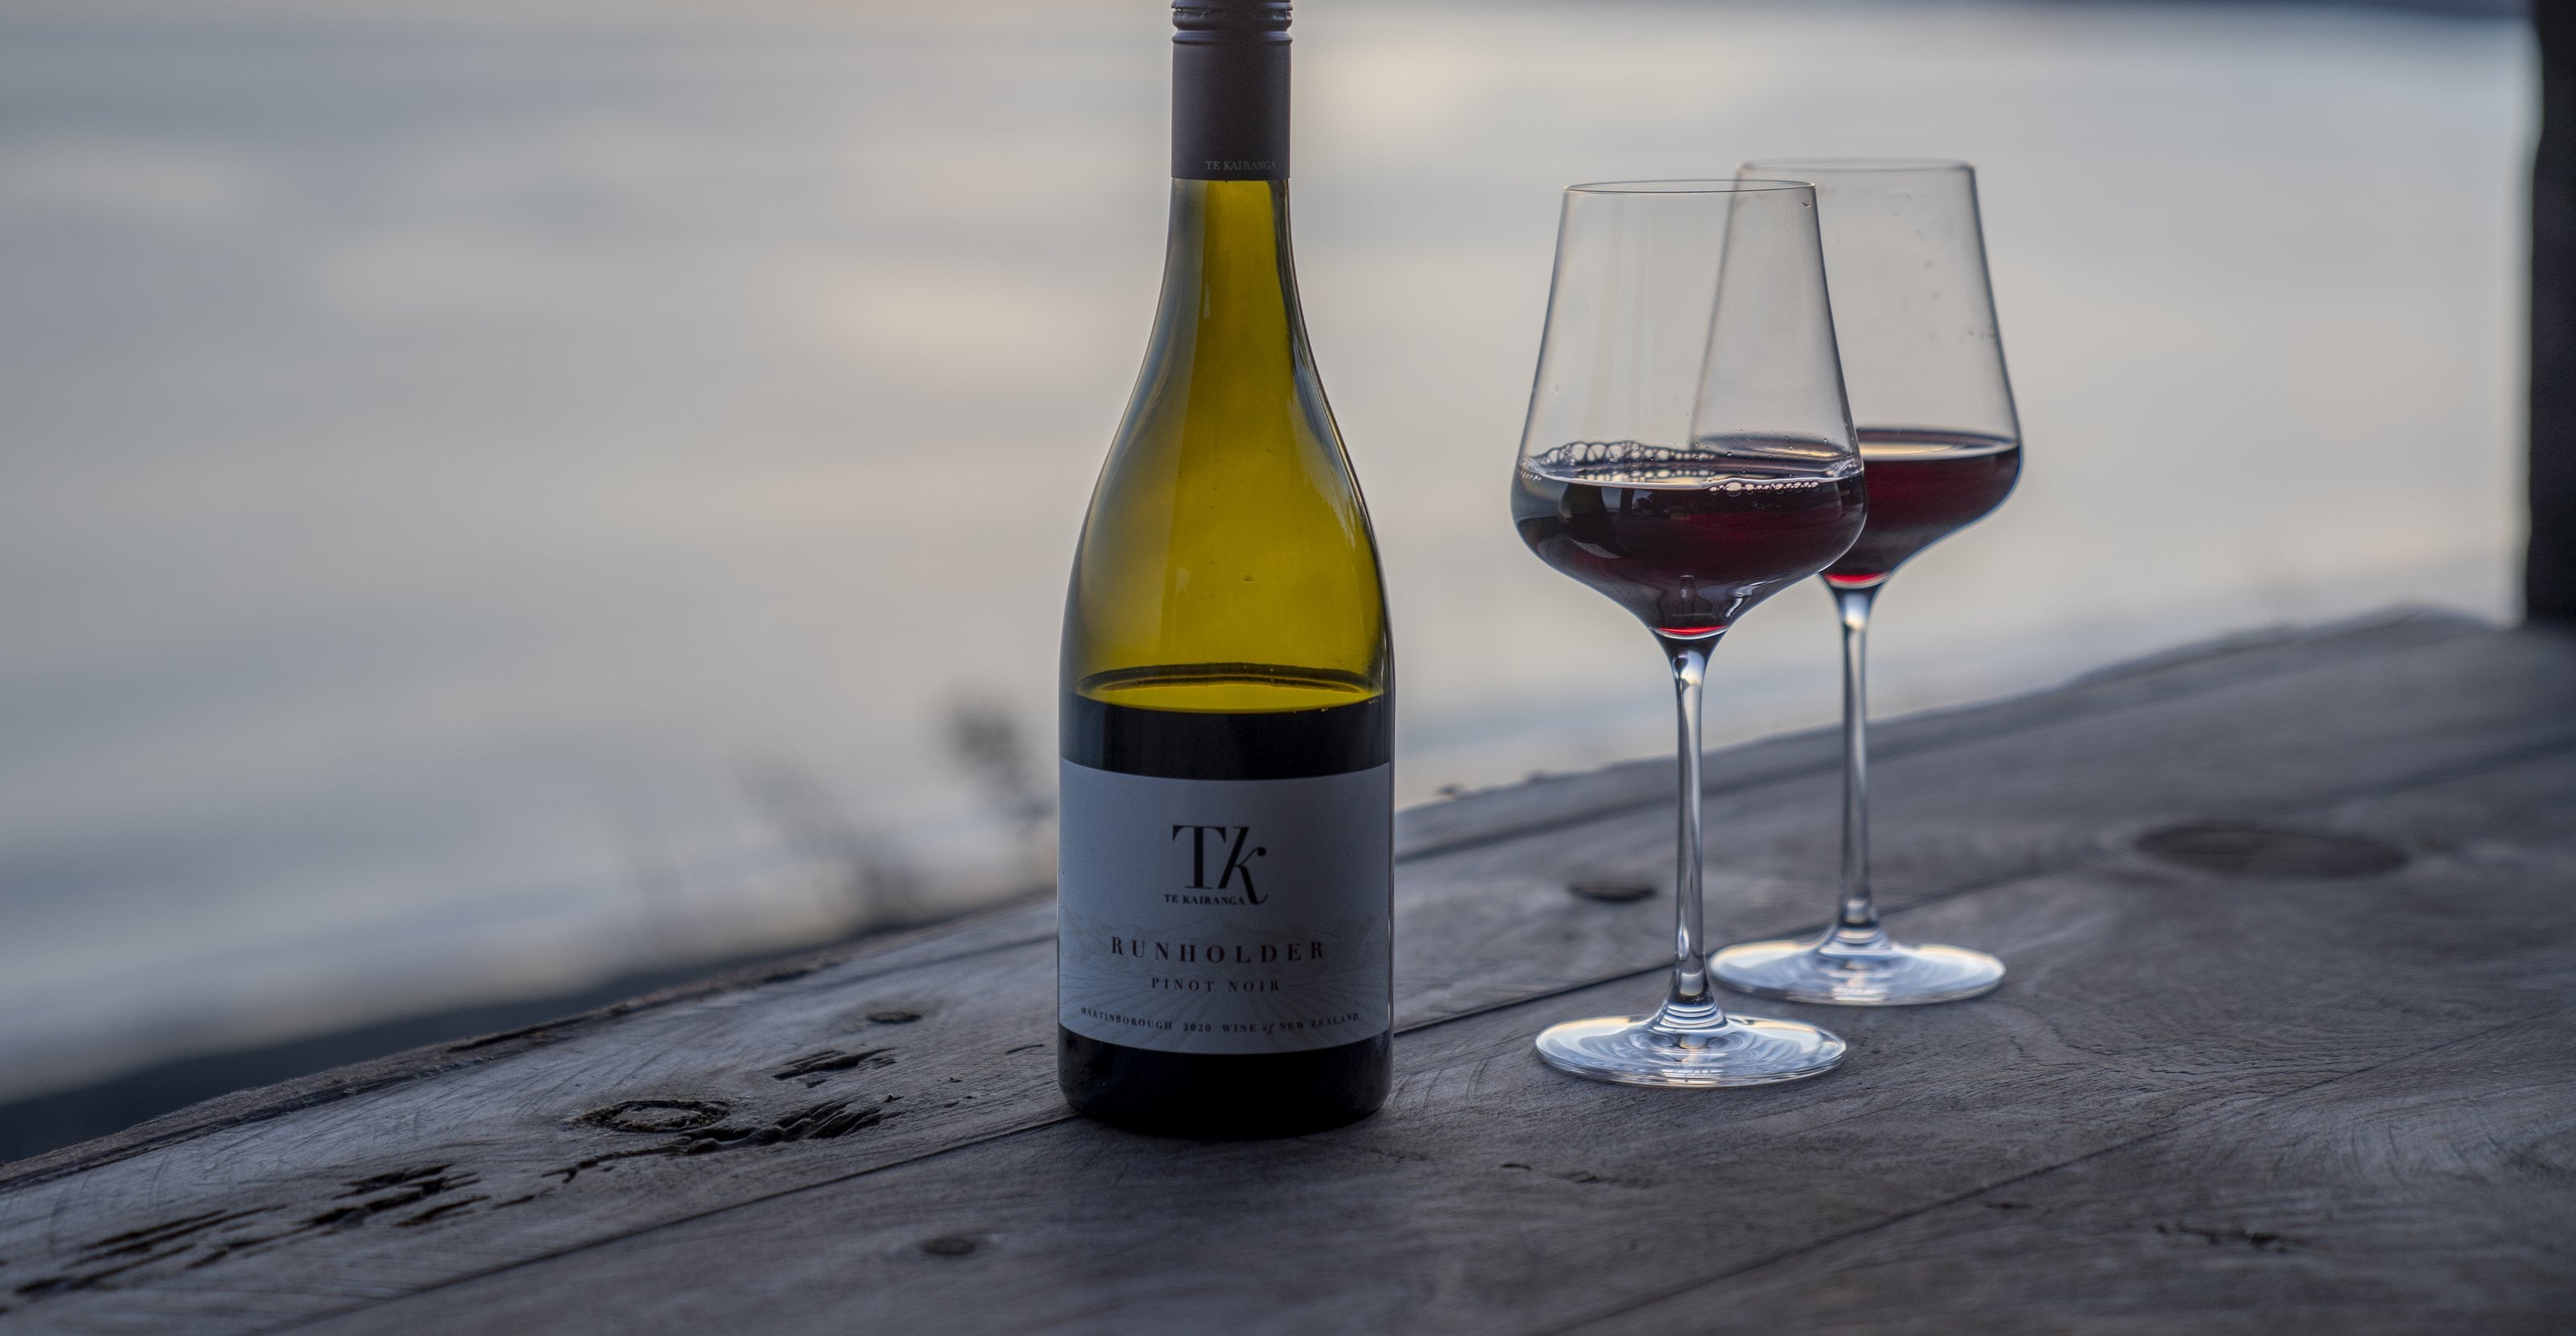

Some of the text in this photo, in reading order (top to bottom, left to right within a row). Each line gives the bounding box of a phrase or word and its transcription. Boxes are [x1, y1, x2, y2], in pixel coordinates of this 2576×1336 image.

[1206, 161, 1220, 170] TE
[1164, 894, 1245, 905] TE KAIRANGA
[1111, 936, 1324, 963] RUNHOLDER
[1151, 977, 1279, 992] PINOT NOIR
[1081, 1007, 1359, 1034] MARTINBOROUGH 2020 WINE of NEW ZEALAND
